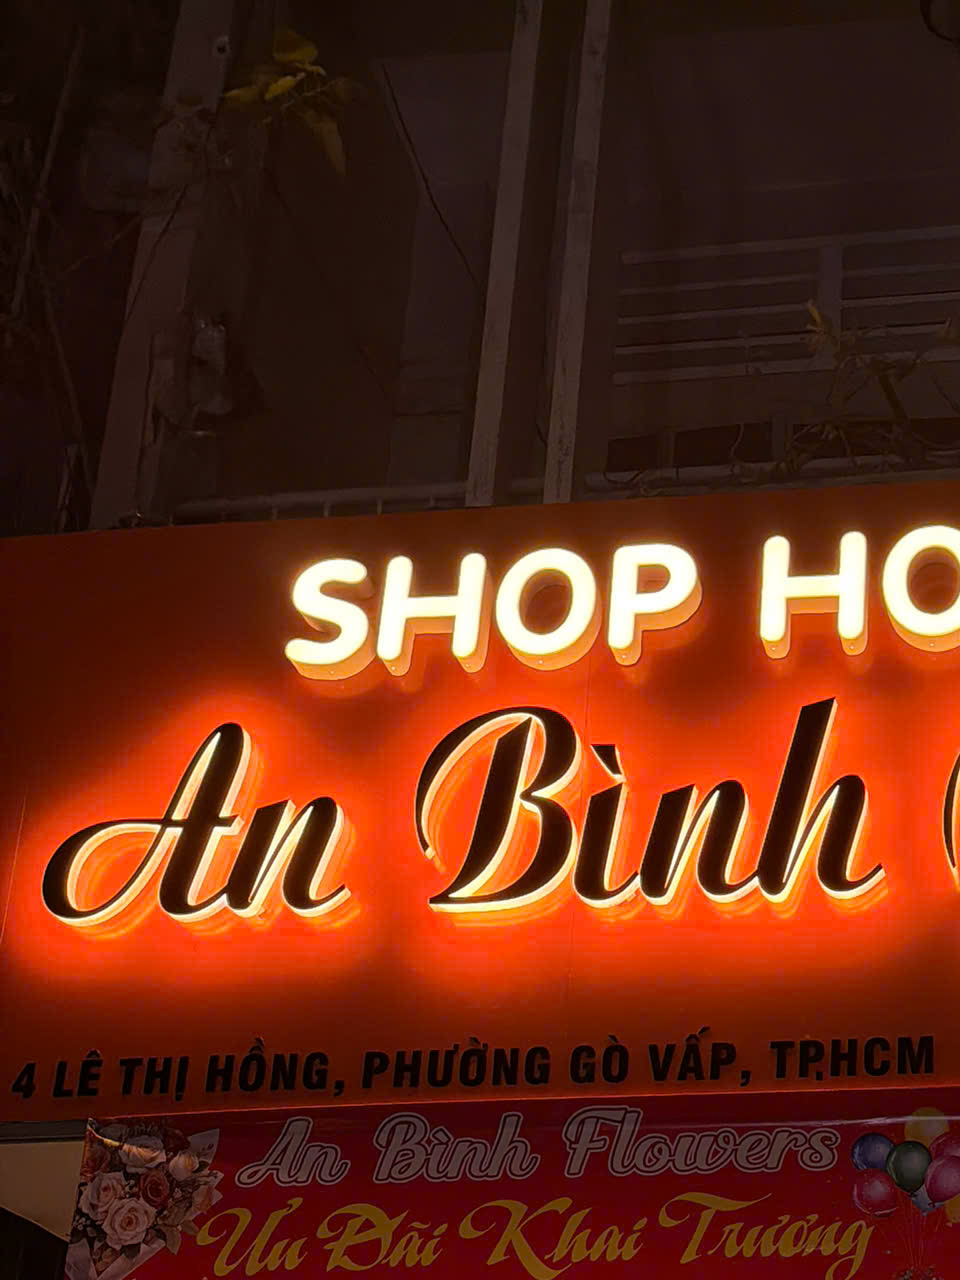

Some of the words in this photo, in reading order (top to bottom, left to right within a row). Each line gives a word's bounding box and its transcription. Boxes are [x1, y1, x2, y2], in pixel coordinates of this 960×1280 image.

[285, 542, 702, 676] SHOP
[42, 722, 352, 924] An
[415, 697, 887, 916] Bình
[12, 1062, 37, 1098] 4
[52, 1049, 104, 1097] LÊ
[119, 1055, 190, 1101] THỊ
[205, 1036, 345, 1096] HỒNG,
[361, 1036, 551, 1089] PHƯỜNG
[569, 1035, 630, 1083] GÒ
[648, 1027, 752, 1086] VẤP,
[769, 1036, 936, 1081] TP.HCM
[235, 1116, 351, 1188] An
[373, 1111, 541, 1184] Bình
[562, 1105, 841, 1178] Flowers
[196, 1197, 308, 1277] Ưu
[316, 1203, 448, 1272] Đãi
[458, 1197, 648, 1280] Khai
